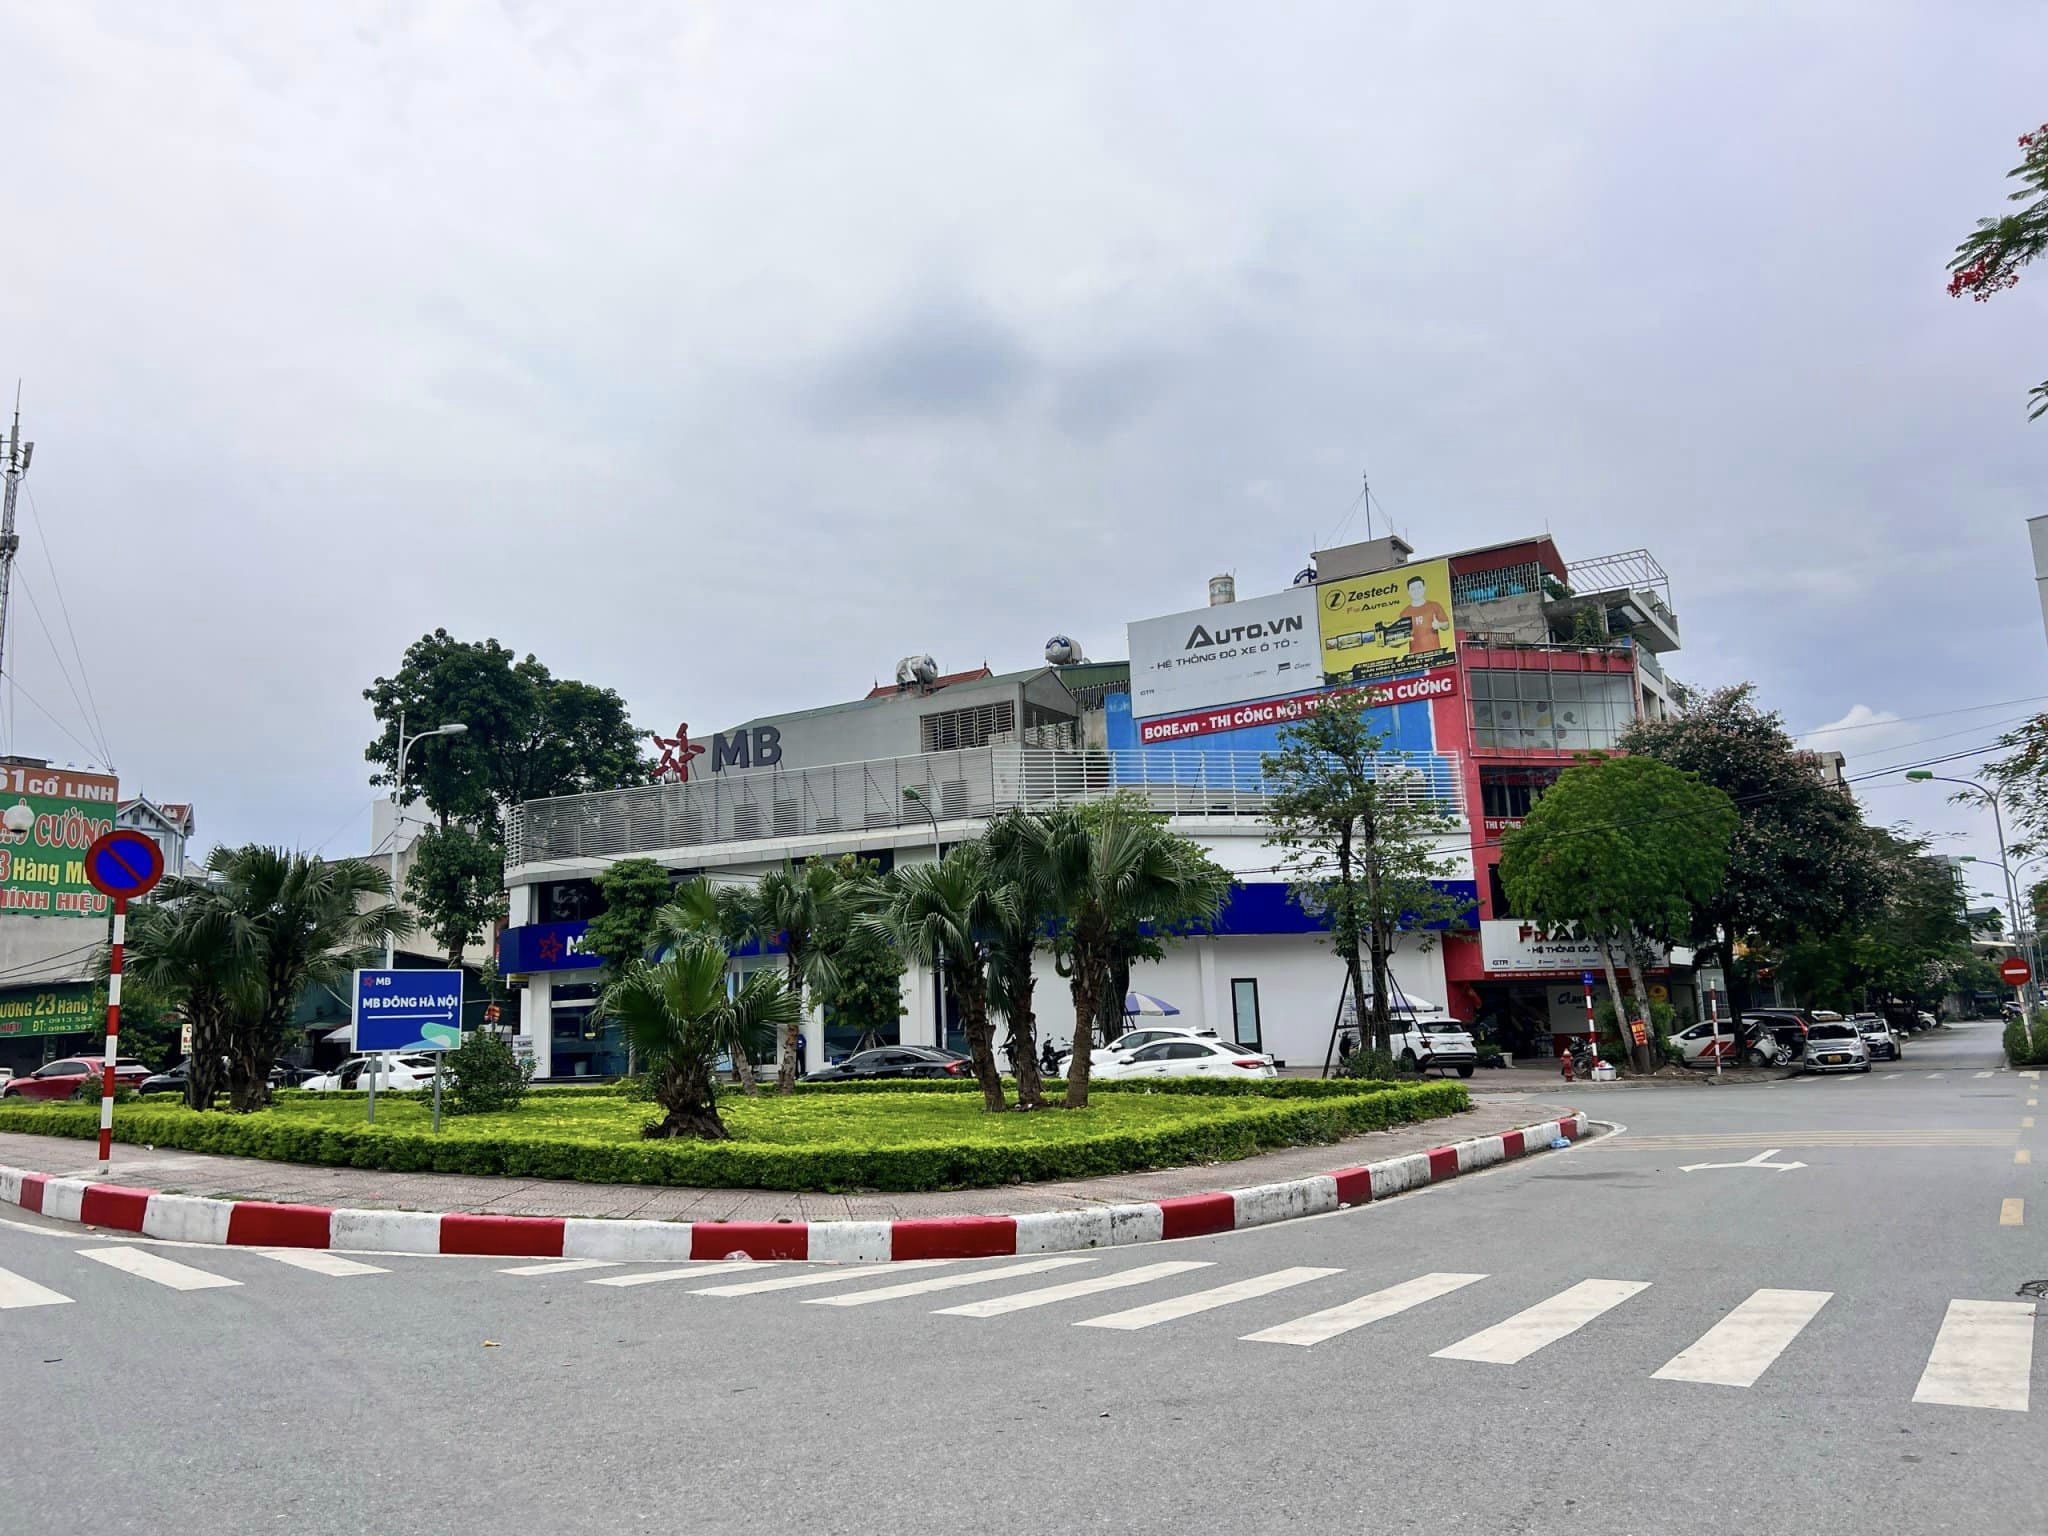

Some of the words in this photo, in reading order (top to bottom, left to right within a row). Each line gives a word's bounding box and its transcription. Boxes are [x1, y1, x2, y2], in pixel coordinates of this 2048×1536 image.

[1348, 583, 1399, 602] Zestech
[1241, 645, 1257, 655] XE
[1144, 721, 1199, 740] BORE.vn
[1209, 716, 1231, 730] THI
[1234, 707, 1273, 724] CÔNG
[1397, 678, 1452, 699] CƯỜNG
[712, 725, 782, 772] MB
[65, 782, 114, 802] LINH
[13, 857, 60, 886] Hàng
[56, 890, 108, 916] HIỆU
[566, 935, 596, 957] M
[375, 977, 391, 986] MB
[34, 993, 56, 1016] 23
[362, 998, 380, 1009] MB
[383, 994, 417, 1008] ĐÔNG
[419, 994, 435, 1008] HÀ
[437, 994, 458, 1010] NỘI
